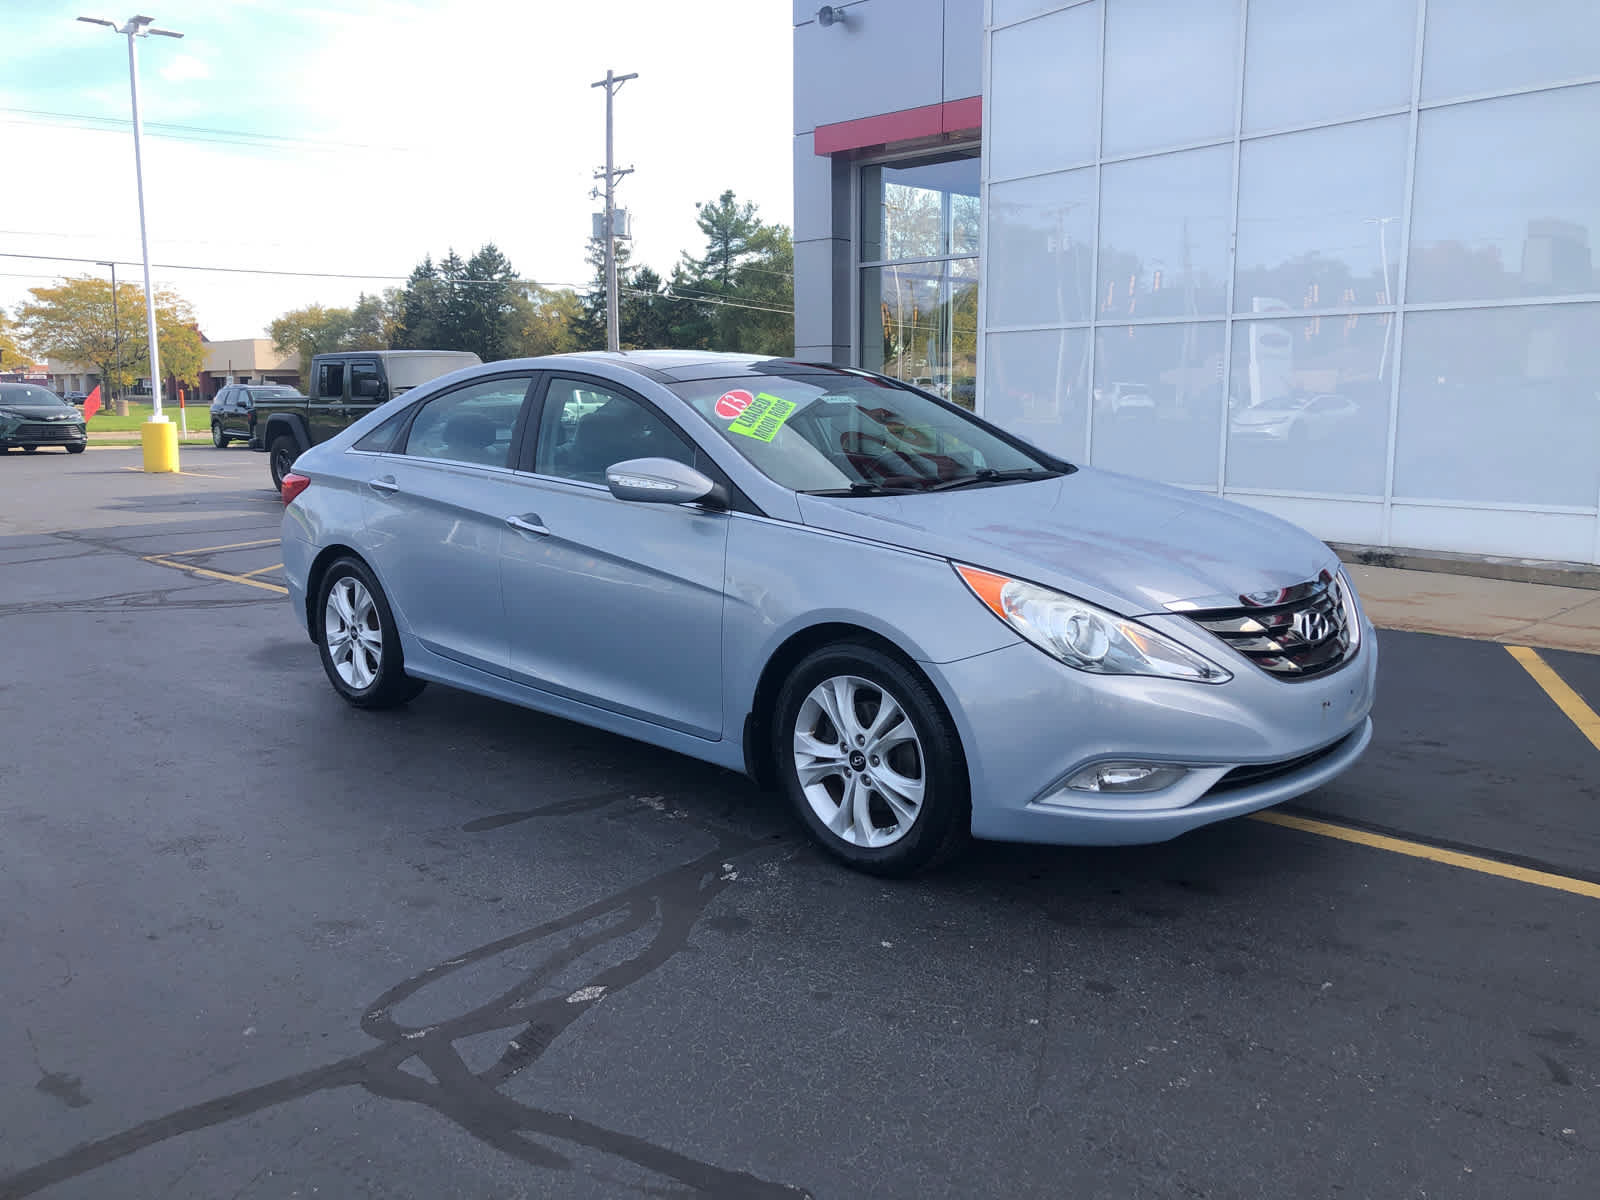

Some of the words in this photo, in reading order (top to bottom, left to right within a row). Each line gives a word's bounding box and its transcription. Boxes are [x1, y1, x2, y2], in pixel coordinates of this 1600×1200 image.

[721, 394, 748, 413] 13
[735, 398, 772, 428] LOADED
[752, 416, 778, 440] MOON
[768, 399, 793, 418] ROOF
